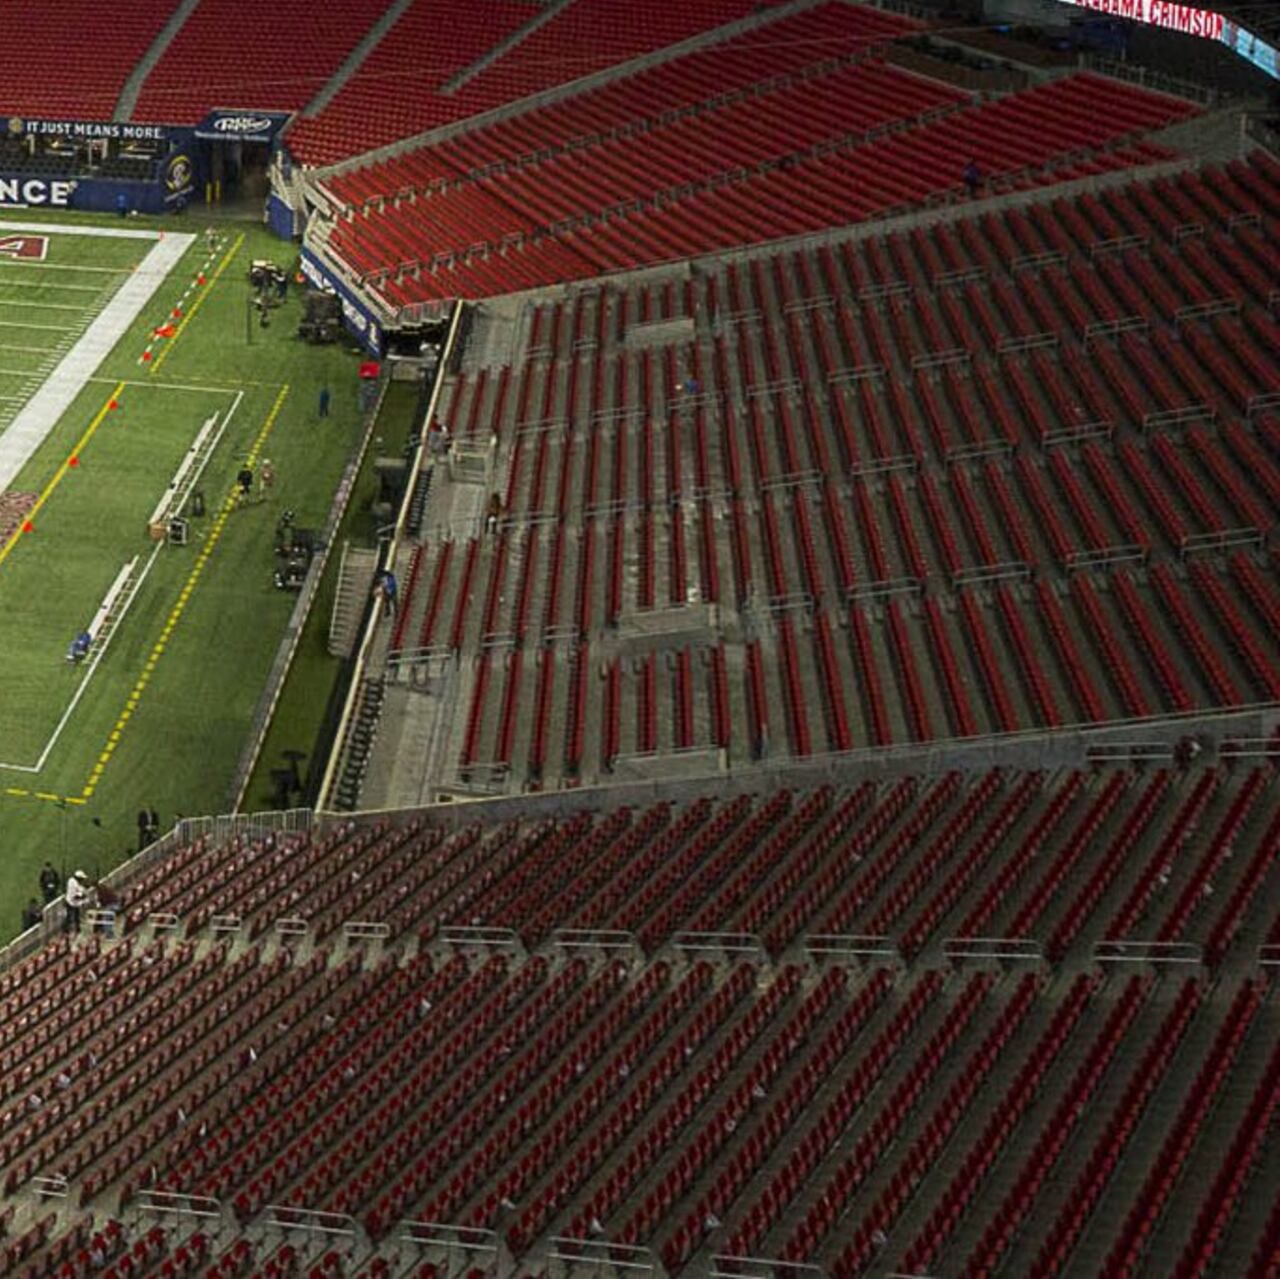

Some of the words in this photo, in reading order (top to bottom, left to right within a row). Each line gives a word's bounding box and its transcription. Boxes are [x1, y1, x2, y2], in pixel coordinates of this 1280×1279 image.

[26, 122, 38, 134] IT
[40, 122, 72, 136] JUST
[74, 124, 120, 138] MEANS
[123, 126, 164, 140] MORE.
